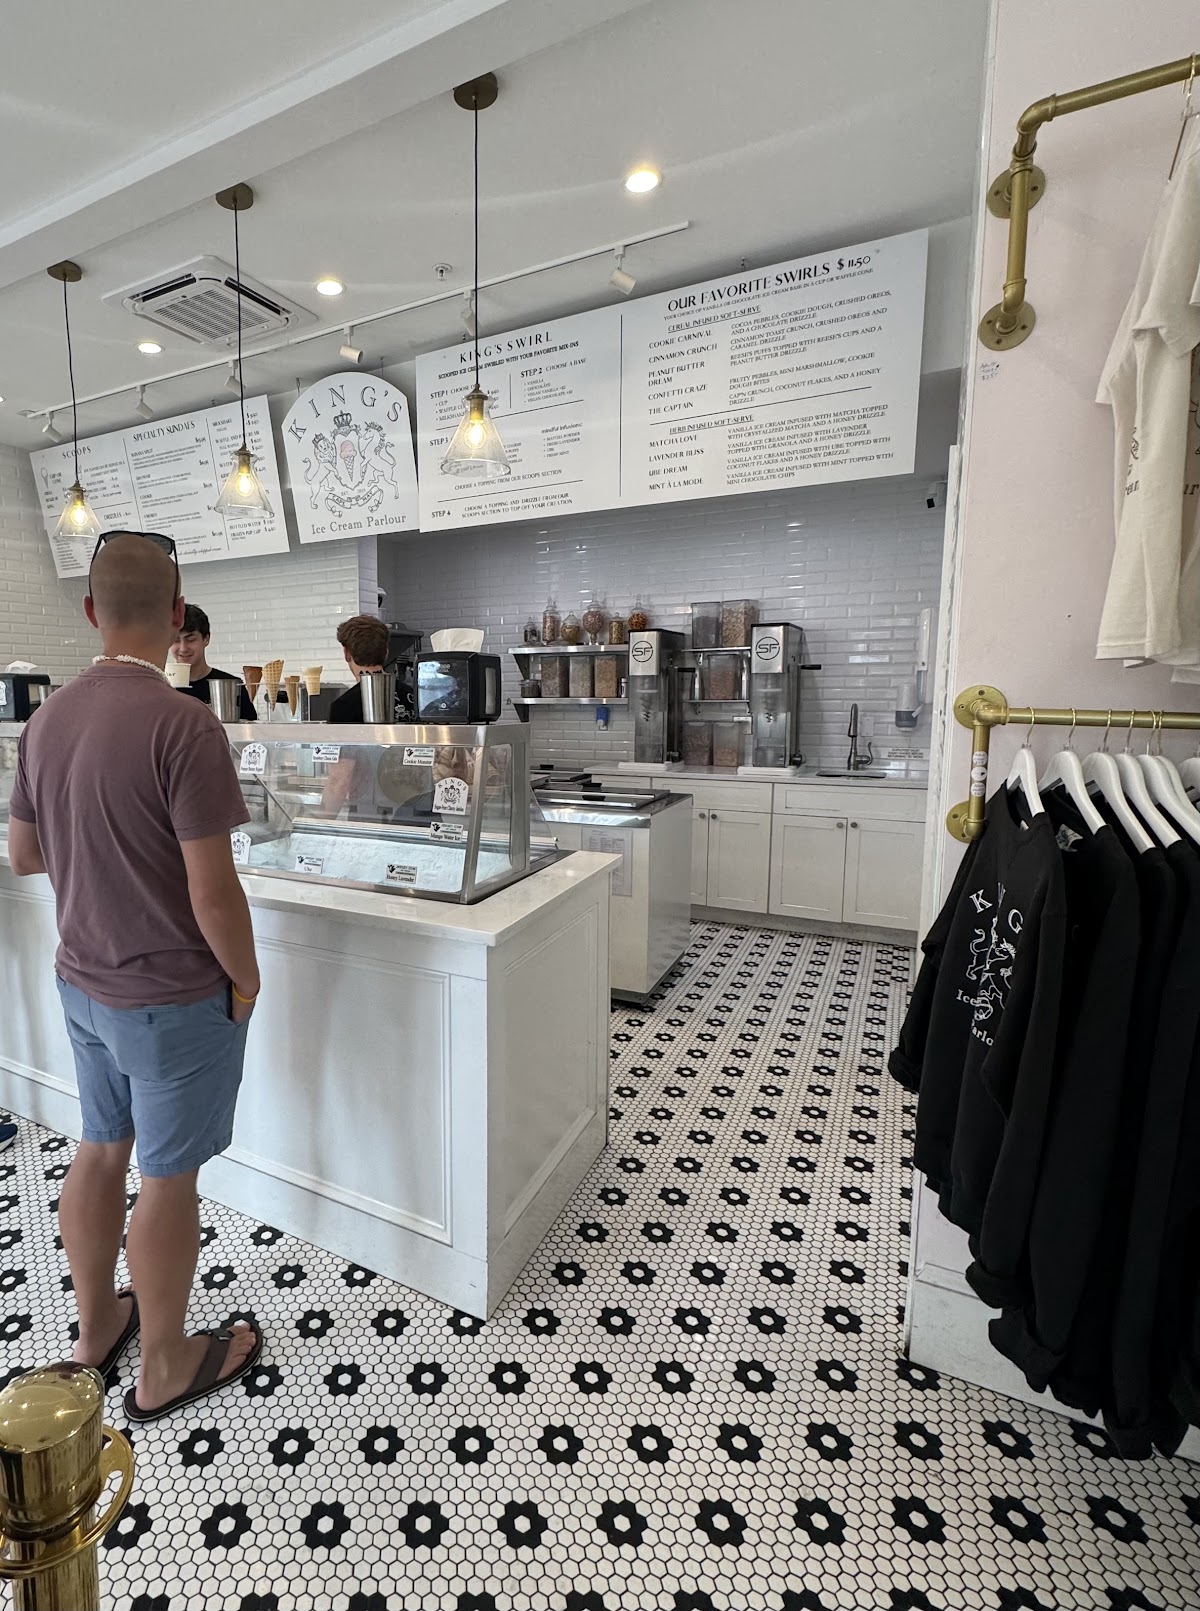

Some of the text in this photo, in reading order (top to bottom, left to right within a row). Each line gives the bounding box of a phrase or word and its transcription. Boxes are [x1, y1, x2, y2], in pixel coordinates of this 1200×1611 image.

[667, 254, 871, 312] OUR FAVORITE SWIRLS $ 11.50
[667, 305, 761, 332] CEREAL INFUSED SOFT-SERVE
[730, 289, 891, 330] COCOA PEBBLES, COOKIE DOUGH, CRUSHED OREOS,
[730, 328, 744, 336] AND
[750, 318, 788, 331] CHOCOLATE
[789, 312, 817, 323] DRIZZLE
[730, 306, 887, 345] CINNAMON TOAST CRUNCH, CRUSHED OREOS AND
[459, 330, 552, 363] KING'S SWIRL
[648, 329, 712, 349] COOKIE CARNIVAL
[730, 334, 786, 351] CARAMEL DRIZZLE
[438, 369, 458, 379] SCOOPED
[484, 358, 504, 368] SWIRLED
[505, 355, 518, 363] WITH
[518, 351, 533, 360] YOUR
[533, 345, 558, 356] FAVORITE
[558, 340, 579, 350] MIX-INS
[648, 342, 717, 363] CINNAMON CRUNCH
[520, 368, 537, 378] STEP
[545, 361, 567, 372] CHOOSE
[573, 357, 586, 365] BASE
[648, 360, 705, 378] PEANUT BUTTER
[729, 351, 875, 384] FRUITY PEBBLES, MINI MARSHMALLOW, COOKIE
[647, 376, 672, 386] DREAM
[728, 391, 746, 399] CAP'N
[747, 386, 774, 396] CRUNCH,
[774, 380, 806, 391] COCONUT
[807, 376, 832, 386] FLAKES,
[832, 373, 848, 381] AND
[856, 367, 881, 377] HONEY
[729, 377, 770, 390] DOUGH BITES
[430, 390, 444, 399] STEP
[450, 384, 470, 394] CHOOSE
[647, 383, 708, 400] CONFETTI CRAZE
[728, 396, 754, 405] DRIZZLE
[288, 385, 402, 443] KING'S
[648, 401, 693, 415] THE CAPTAIN
[132, 419, 195, 442] SPECIALTY SUNDAES
[669, 414, 754, 433] HERB INFUSED SOFT-SERVE
[429, 437, 444, 446] STEP
[649, 434, 697, 448] MATCHA LOVE
[61, 445, 92, 459] SCOOPS
[648, 448, 704, 462] LAVENDER BLISS
[454, 482, 472, 490] CHOOSE
[521, 472, 540, 480] SCOOPS
[541, 468, 562, 477] SECTION
[663, 465, 688, 475] DREAM
[648, 476, 703, 490] MINT À LA MODE
[461, 510, 480, 518] SCOOPS
[480, 508, 501, 516] SECTION
[546, 498, 573, 507] CREATION
[464, 504, 483, 512] CHOOSE
[488, 500, 508, 508] TOPPING
[521, 496, 541, 504] DRIZZLE
[431, 510, 446, 518] STEP
[311, 514, 407, 535] Ice Cream Parlour
